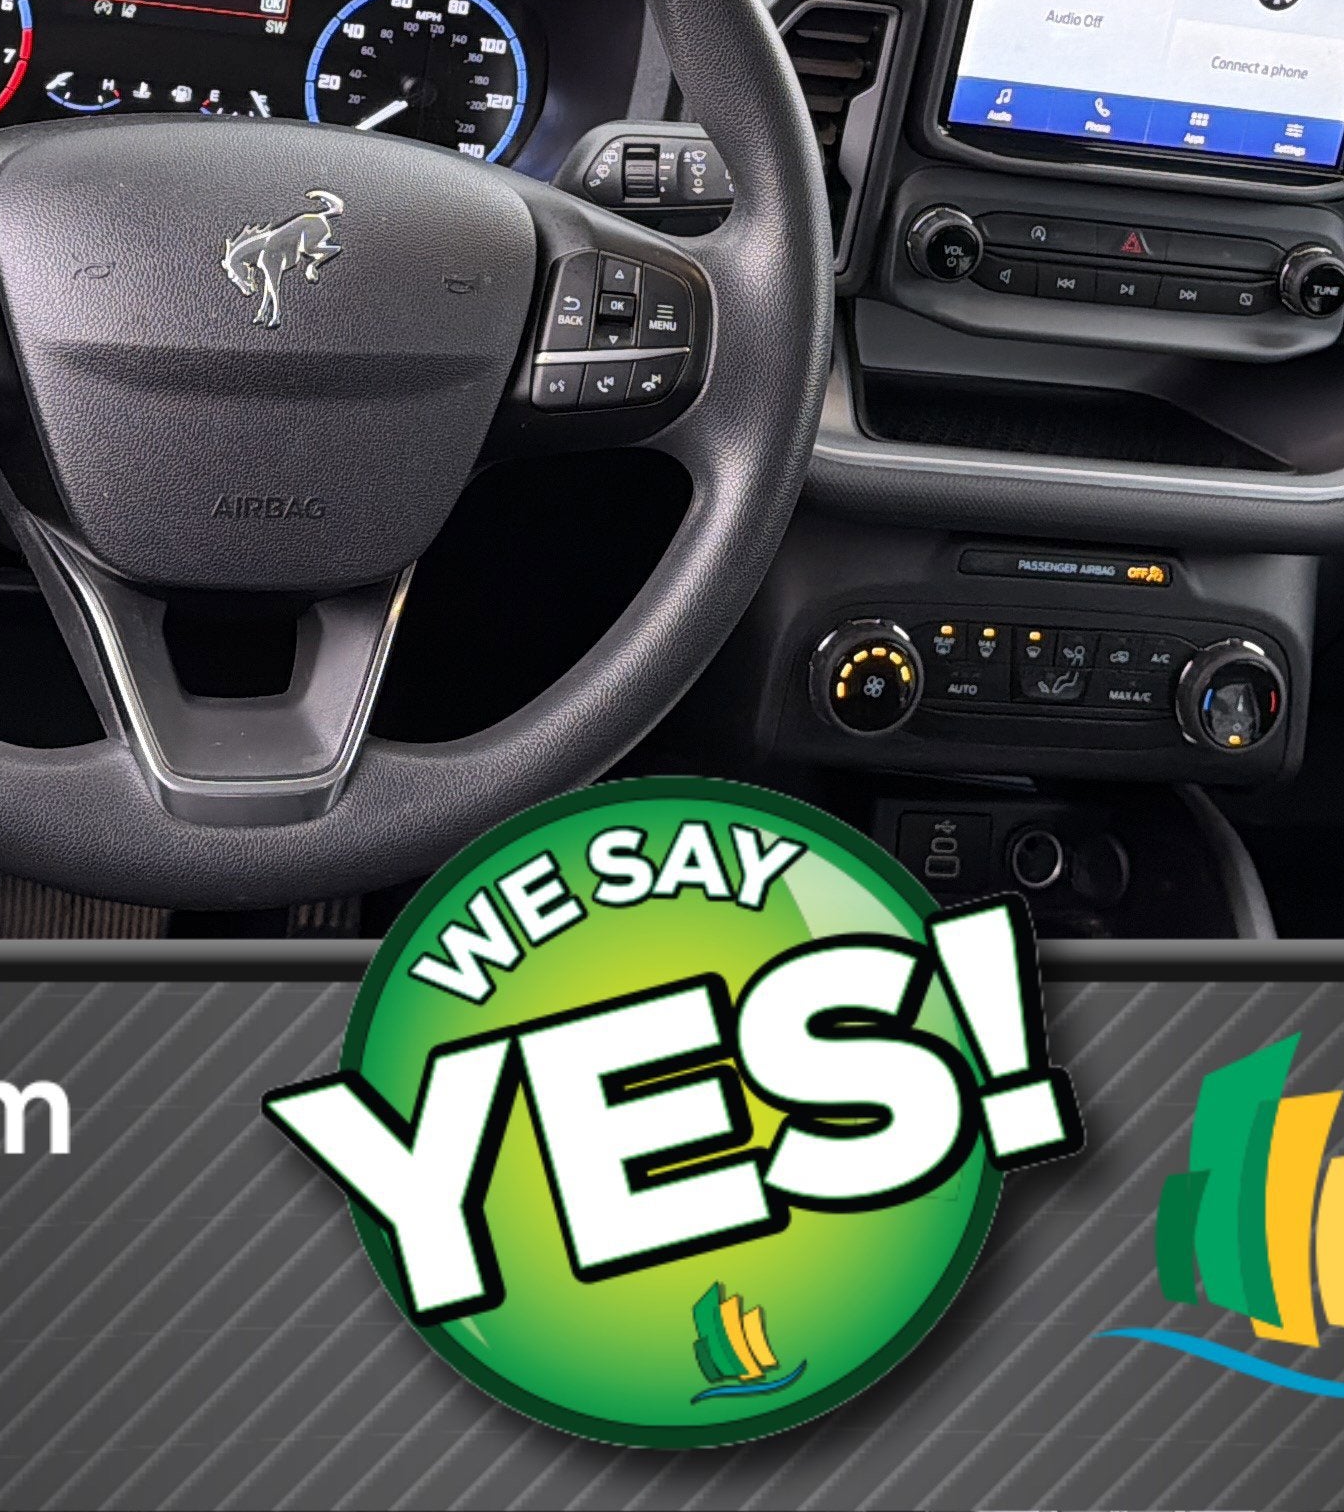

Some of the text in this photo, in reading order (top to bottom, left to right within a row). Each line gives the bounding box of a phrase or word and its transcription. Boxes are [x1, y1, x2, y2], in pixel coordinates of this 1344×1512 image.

[448, 0, 470, 15] 80
[415, 10, 442, 22] MPH
[1045, 9, 1104, 29] Audio Off
[265, 20, 288, 34] SW
[343, 23, 365, 39] 40
[403, 22, 420, 33] 100
[430, 24, 445, 34] 120
[380, 29, 394, 39] 80
[452, 34, 468, 45] 140
[360, 46, 374, 56] 60
[480, 37, 507, 54] 100
[3, 49, 16, 63] 7
[468, 53, 484, 63] 160
[349, 69, 362, 79] 40
[1211, 55, 1309, 80] Connect a phone
[103, 78, 115, 91] H
[318, 74, 341, 90] 20
[474, 75, 490, 85] 180
[210, 89, 220, 102] E
[347, 94, 361, 105] 20
[486, 93, 513, 109] 120
[469, 100, 487, 111] 200
[987, 109, 1013, 123] Audio
[457, 122, 475, 134] 220
[1085, 120, 1111, 134] Phone
[1183, 131, 1206, 146] Apps
[458, 142, 485, 158] 140
[1273, 143, 1307, 157] Settings
[943, 245, 965, 258] VOL
[1312, 284, 1340, 297] TUNE
[611, 300, 624, 311] OK
[558, 314, 583, 326] BACK
[649, 320, 677, 332] MENU
[210, 495, 326, 521] AIRBAG
[1017, 559, 1148, 580] PASSENGER AIRBAG OFF
[1151, 653, 1171, 664] A/C
[947, 684, 978, 695] AUTO
[1109, 690, 1152, 703] MAX A/C
